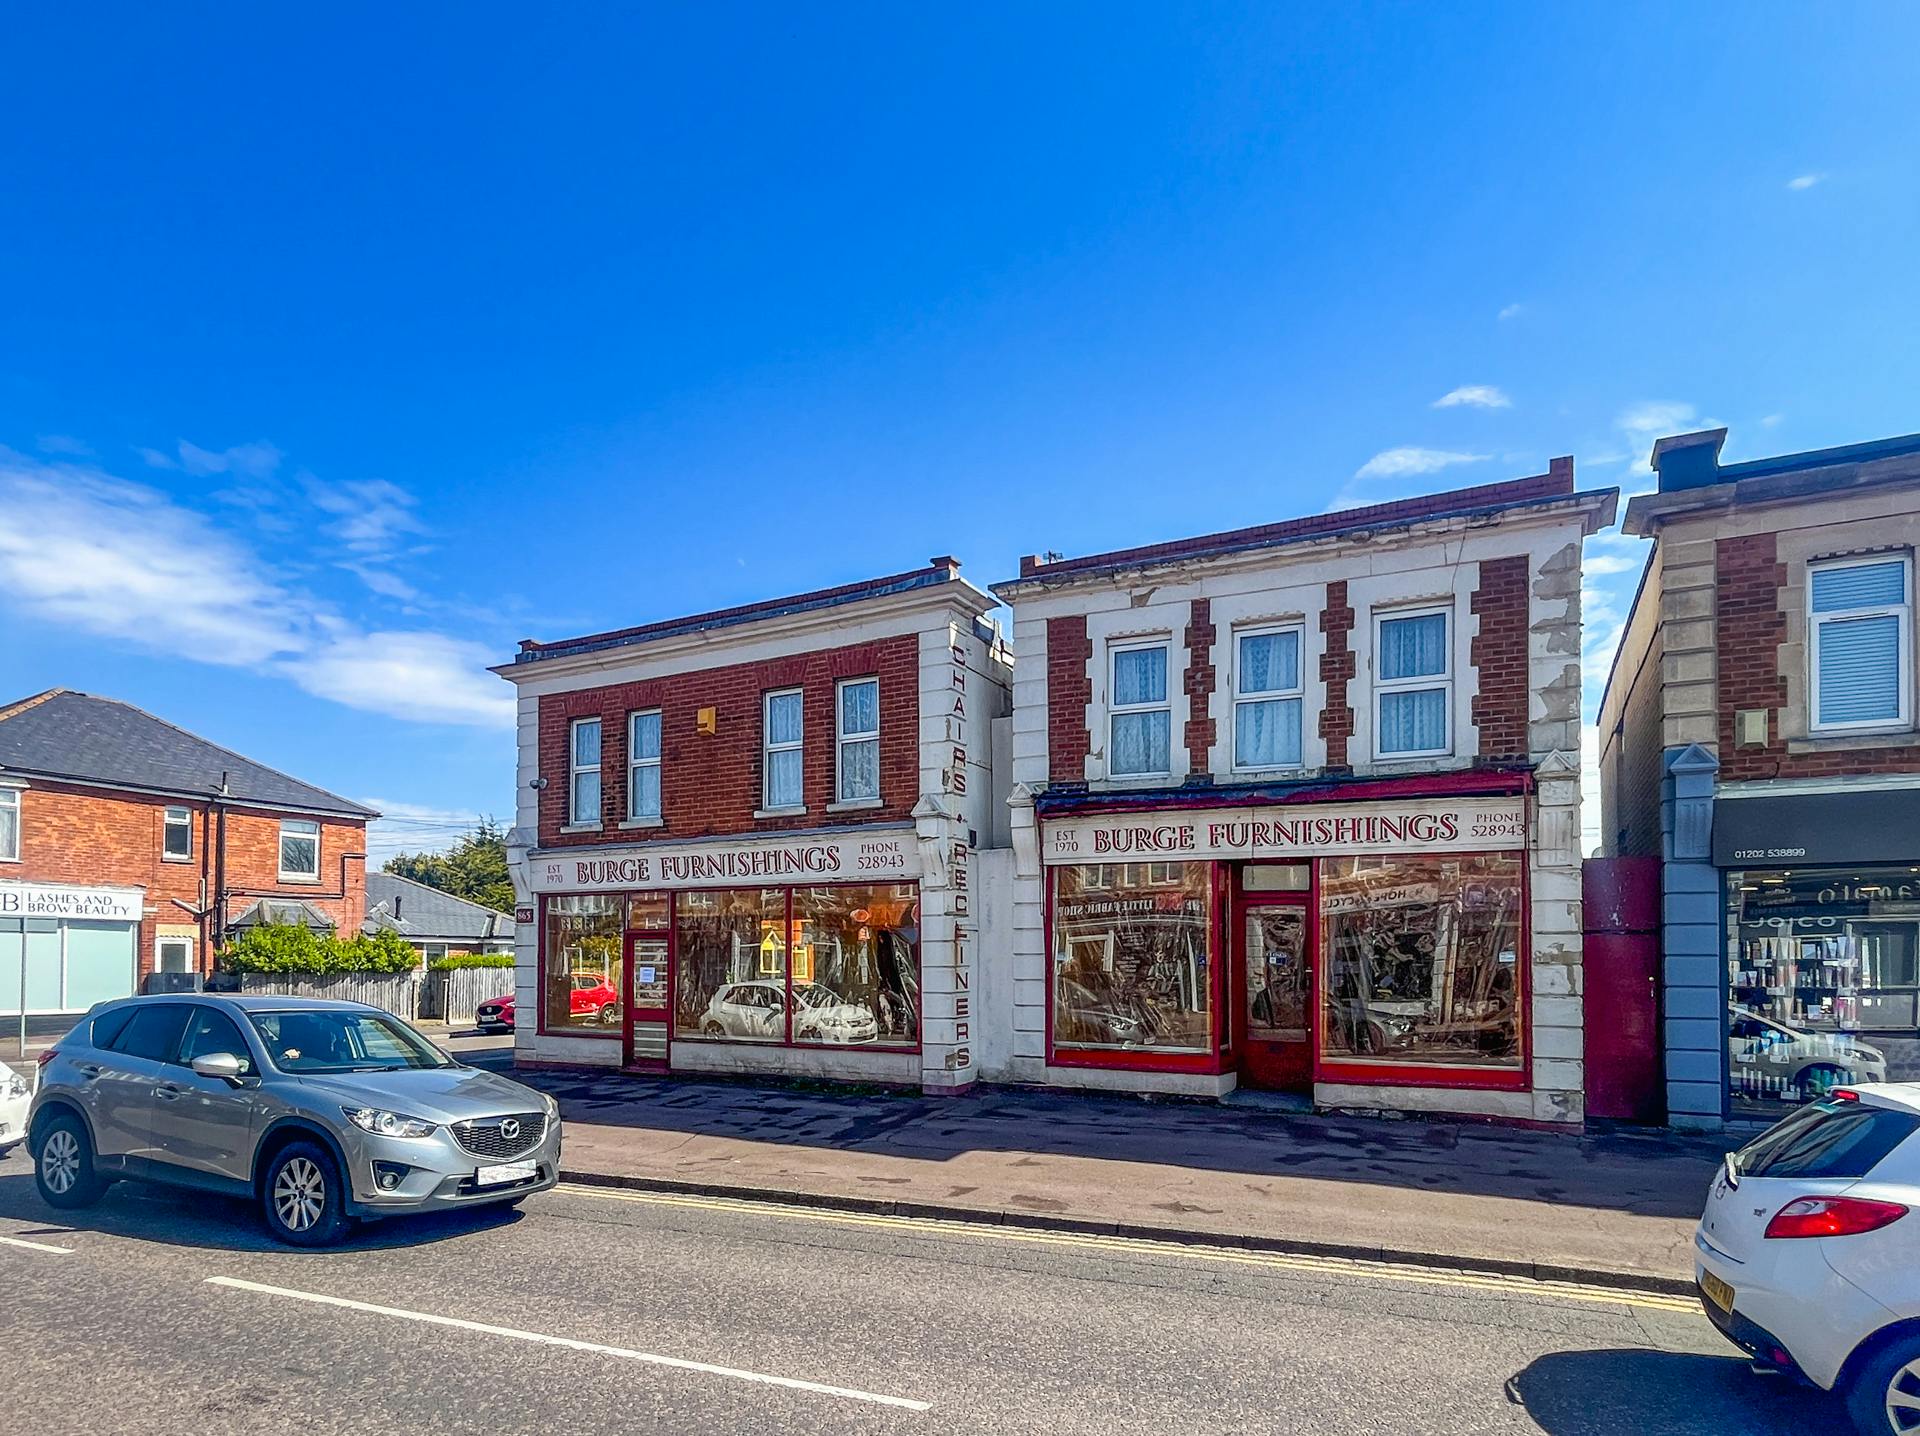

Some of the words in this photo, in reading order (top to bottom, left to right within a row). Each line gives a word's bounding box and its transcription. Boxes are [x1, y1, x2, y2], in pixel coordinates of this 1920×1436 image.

[952, 645, 967, 793] CHAIRS
[1476, 812, 1521, 823] PHONE
[1056, 830, 1076, 841] EST
[1093, 824, 1195, 854] BURGE
[1208, 813, 1459, 849] FURNISHINGS
[1470, 823, 1527, 838] 528943
[860, 841, 900, 854] PHONE
[1054, 841, 1079, 852] 1970
[1734, 850, 1765, 860] 01202
[1767, 848, 1806, 858] 538899
[547, 864, 561, 874] EST
[576, 858, 651, 885] BURGE
[660, 845, 841, 881] FURNISHINGS
[857, 854, 905, 870] 528943
[546, 874, 564, 884] 1970
[0, 892, 20, 912] B
[28, 892, 80, 904] LASHES
[83, 895, 113, 906] AND
[28, 902, 71, 913] BROW
[76, 905, 130, 916] BEAUTY
[517, 911, 531, 921] 865
[1748, 915, 1837, 929] JOICO
